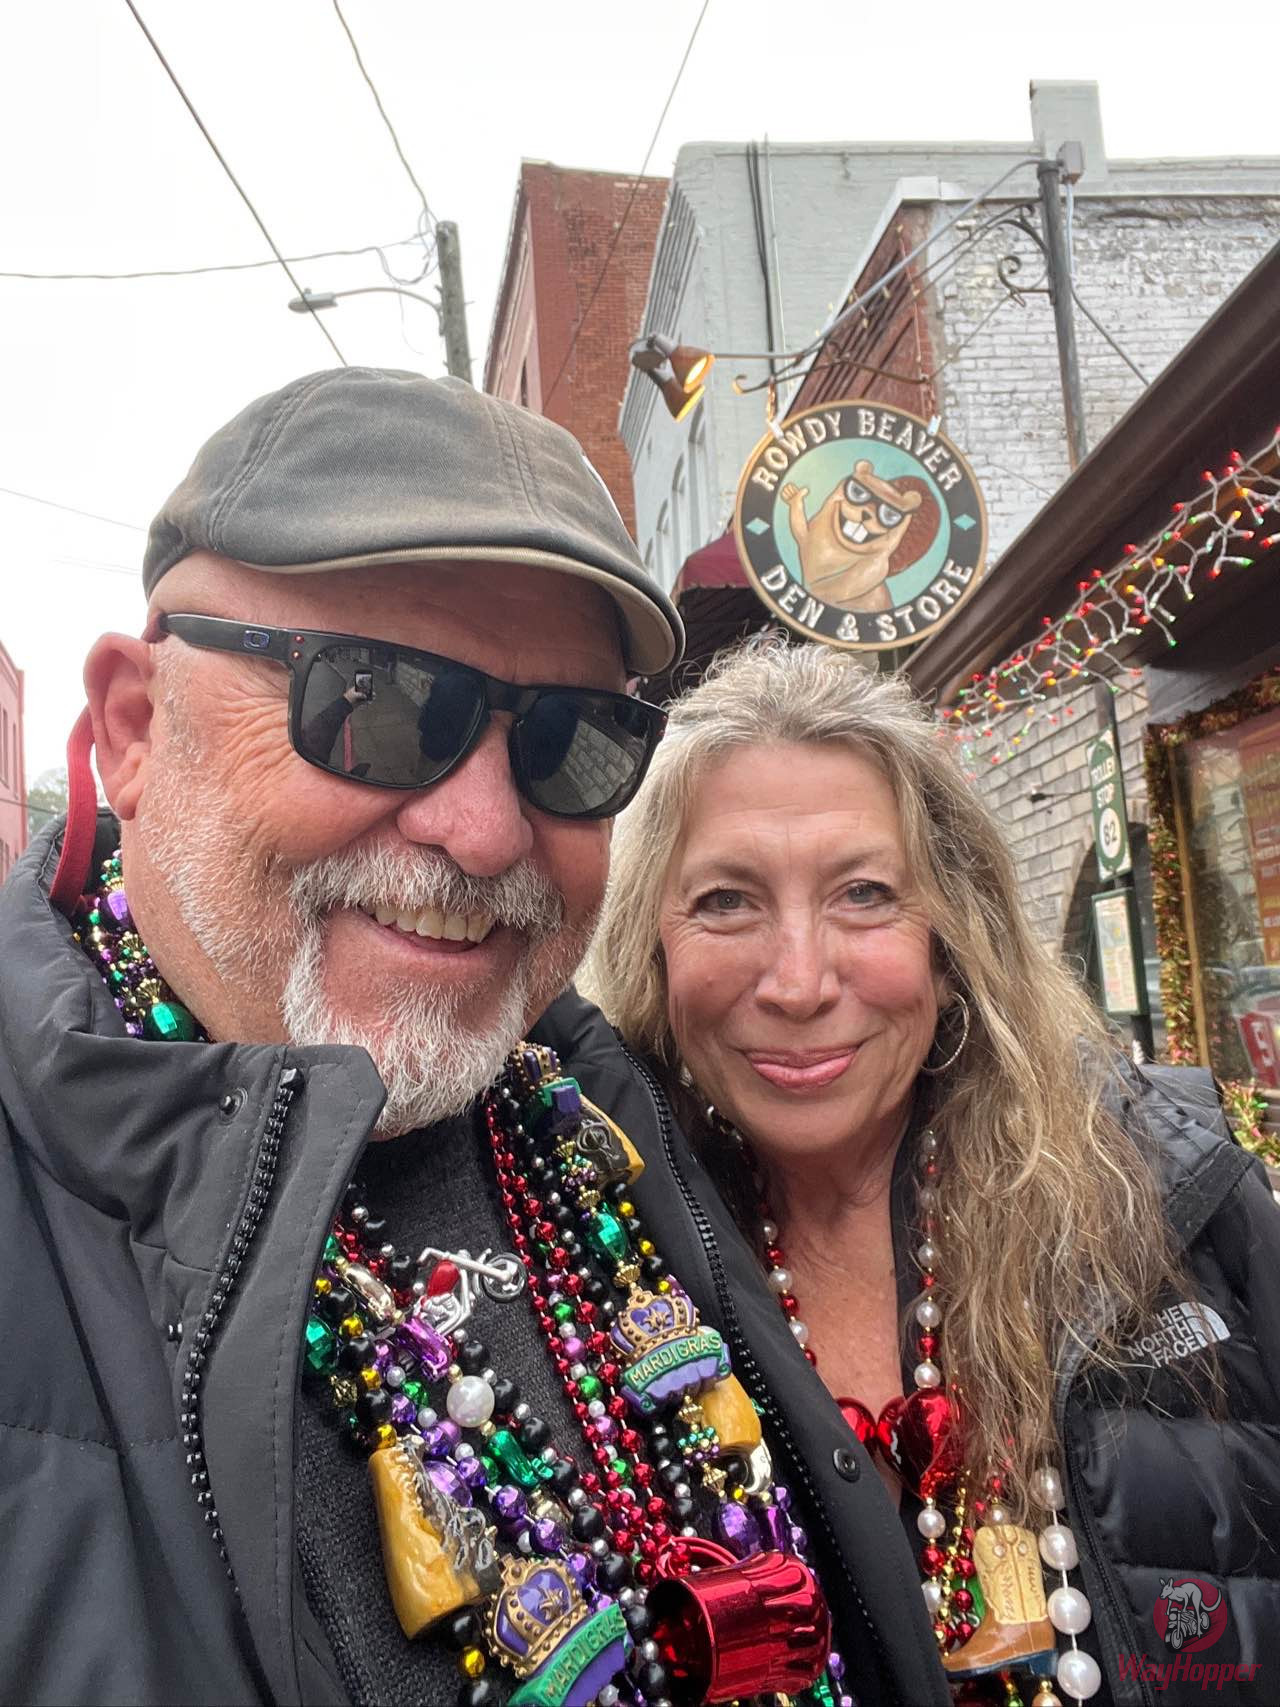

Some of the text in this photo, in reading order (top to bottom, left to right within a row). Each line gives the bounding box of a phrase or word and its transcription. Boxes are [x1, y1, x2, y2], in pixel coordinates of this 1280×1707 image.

[752, 408, 962, 491] ROWDY BEAVER
[761, 559, 973, 641] DEN & STORE
[1096, 783, 1115, 808] STOP
[1103, 821, 1117, 846] 82
[629, 1335, 721, 1385] MARDI GRAS
[1128, 1320, 1193, 1361] NORTH
[1151, 1336, 1201, 1368] FACE
